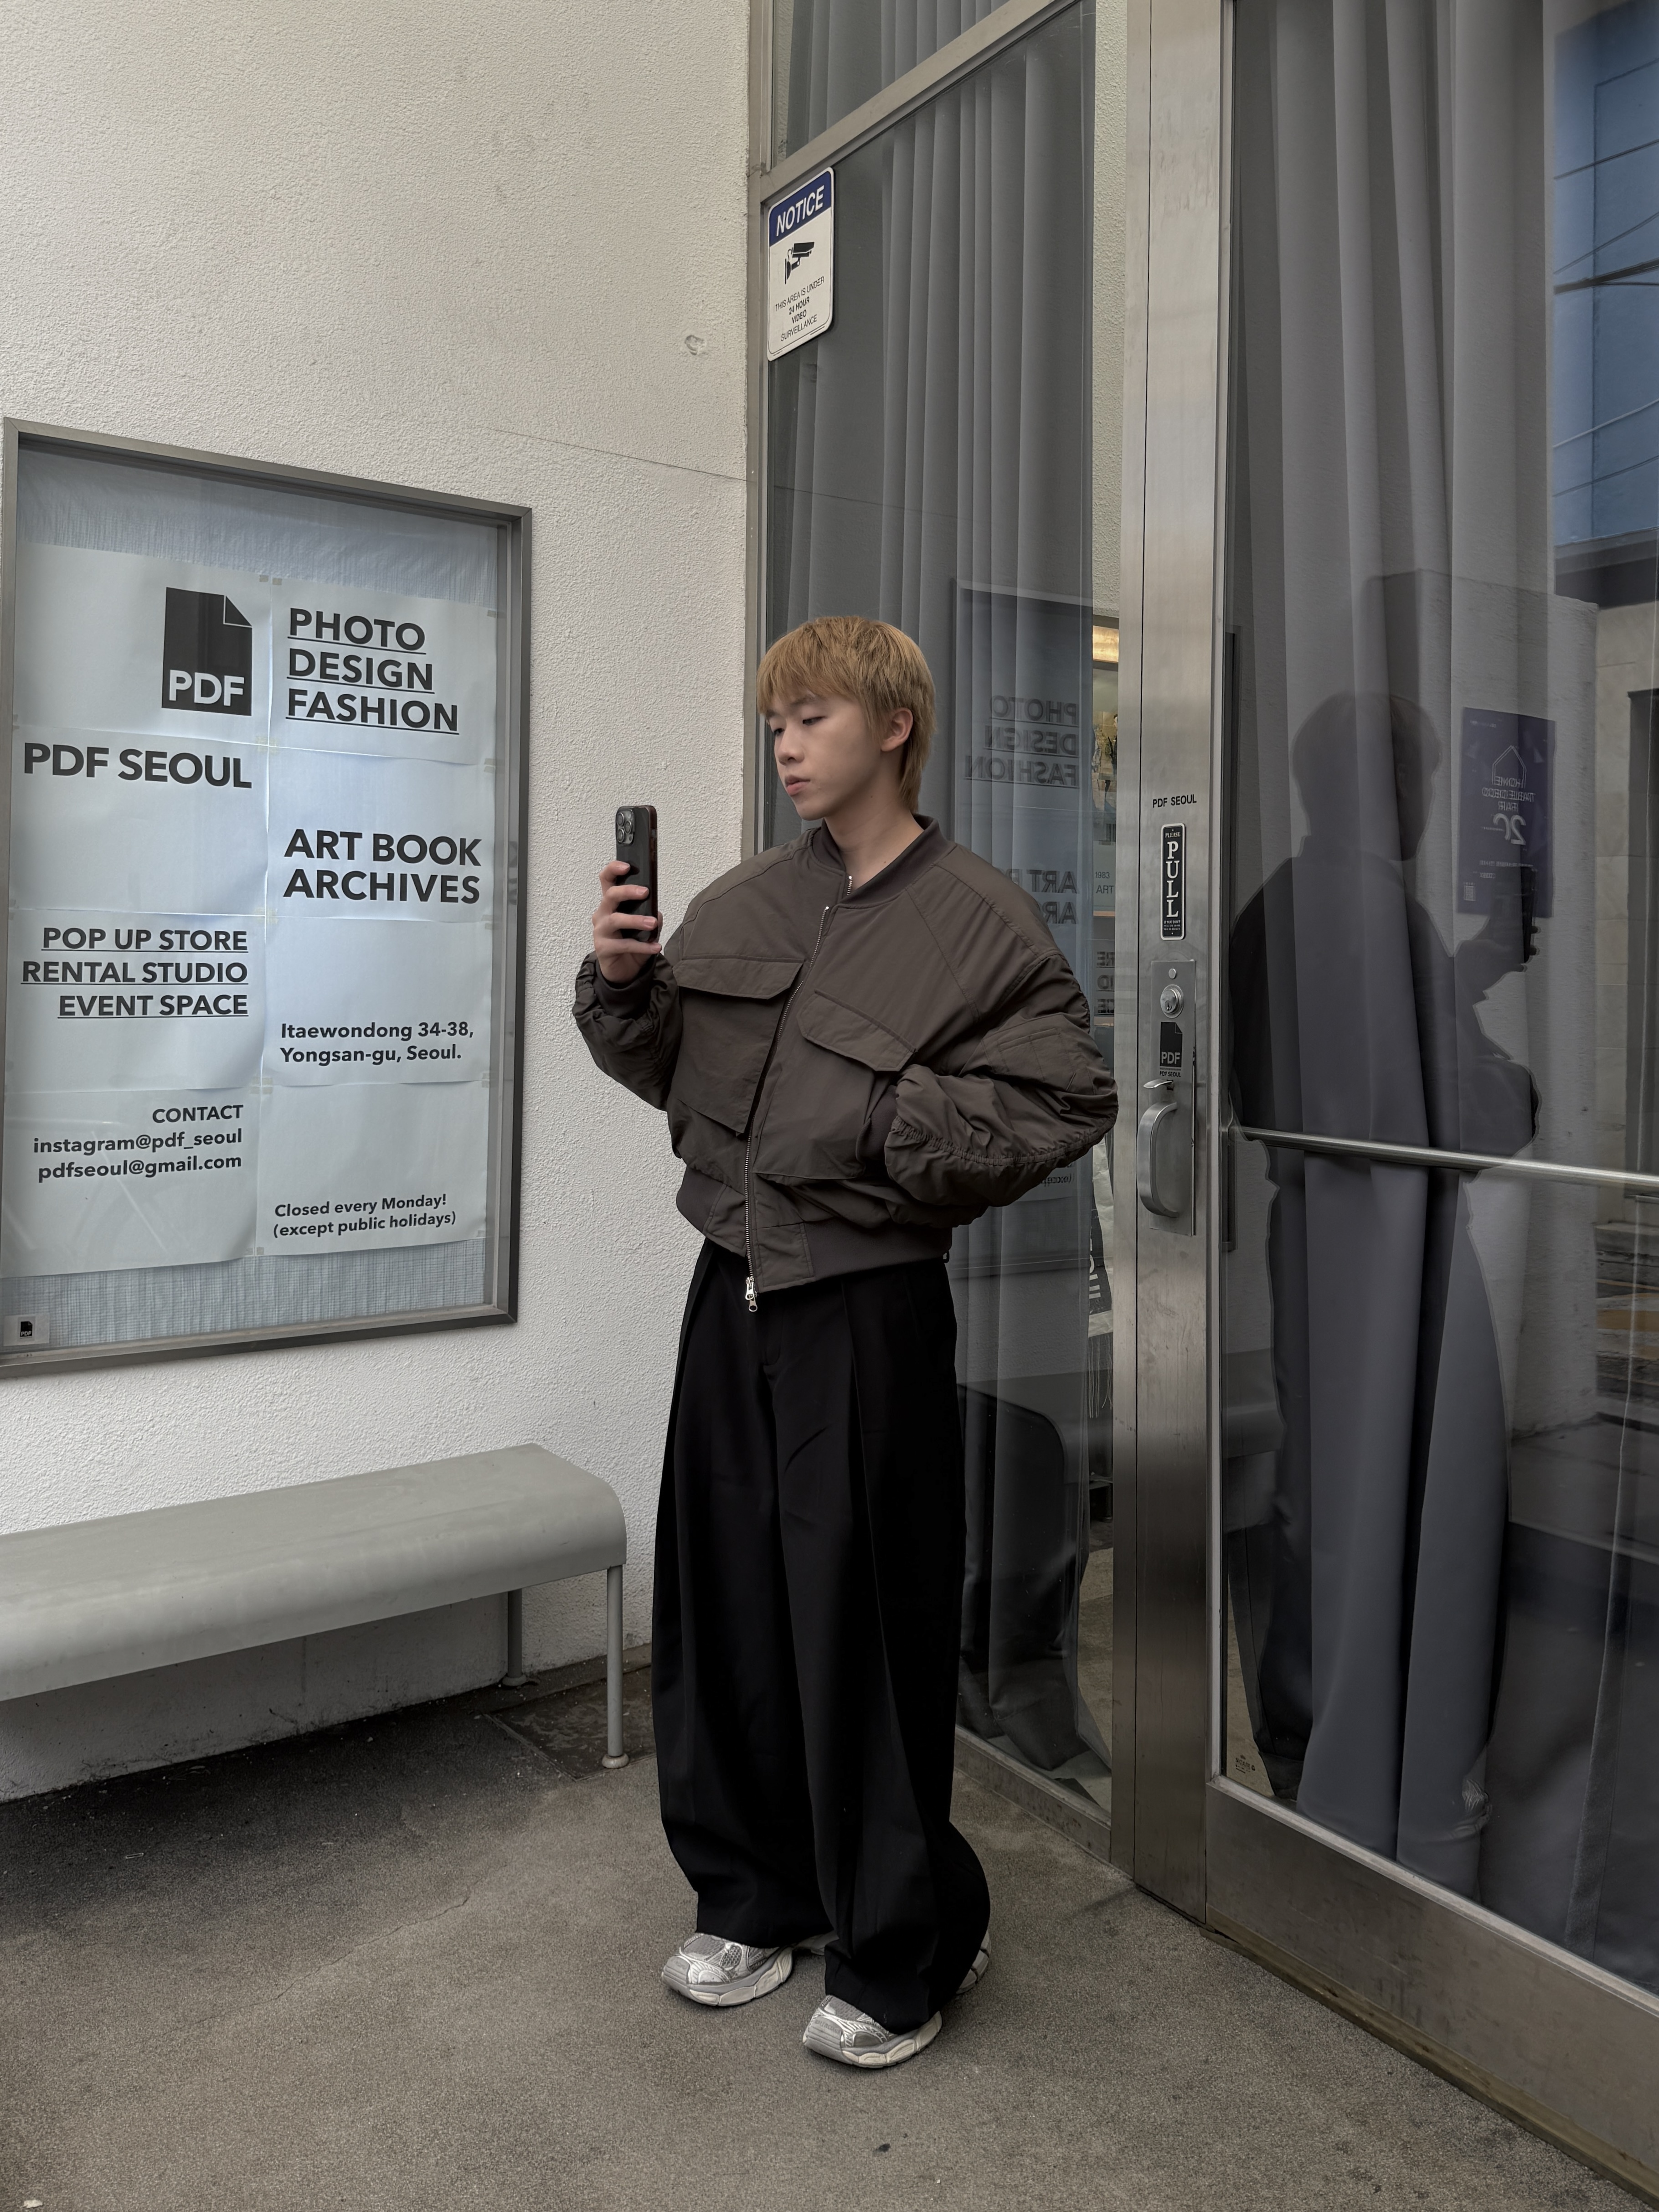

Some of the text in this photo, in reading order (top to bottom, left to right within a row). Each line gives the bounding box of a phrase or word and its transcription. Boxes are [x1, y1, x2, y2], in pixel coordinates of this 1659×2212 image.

[776, 185, 824, 237] NOTICE
[775, 276, 824, 311] THIS AREA IS UNDER
[789, 296, 810, 315] 24 HOUR
[781, 314, 817, 341] SURVEILLANCE
[792, 309, 807, 324] VIDEO
[290, 608, 426, 651] PHOTO
[289, 648, 433, 690] DESIGN
[169, 670, 245, 706] PDF
[288, 688, 458, 731] FASHION
[24, 742, 252, 789] PDF SEOUL
[1153, 794, 1197, 808] PDF SEOUL
[284, 829, 483, 866] ART BOOK
[283, 869, 480, 904] ARCHIVES
[1096, 885, 1114, 894] ART
[1166, 841, 1180, 918] PULL
[44, 928, 247, 951] POP UP STORE
[23, 961, 247, 983] RENTAL STUDIO
[59, 995, 248, 1016] EVENT SPACE
[281, 1021, 474, 1041] Itaewondong 34-38,
[280, 1044, 462, 1066] Yongsan-gu, Seoul.
[1161, 1052, 1180, 1064] PDF
[152, 1105, 244, 1124] CONTACT
[33, 1128, 242, 1155] instagram@pdf_seoul
[38, 1156, 242, 1183] pdfseoul@gmail.com
[275, 1194, 447, 1217] Closed every Monday!
[273, 1211, 456, 1238] (except public holidays)
